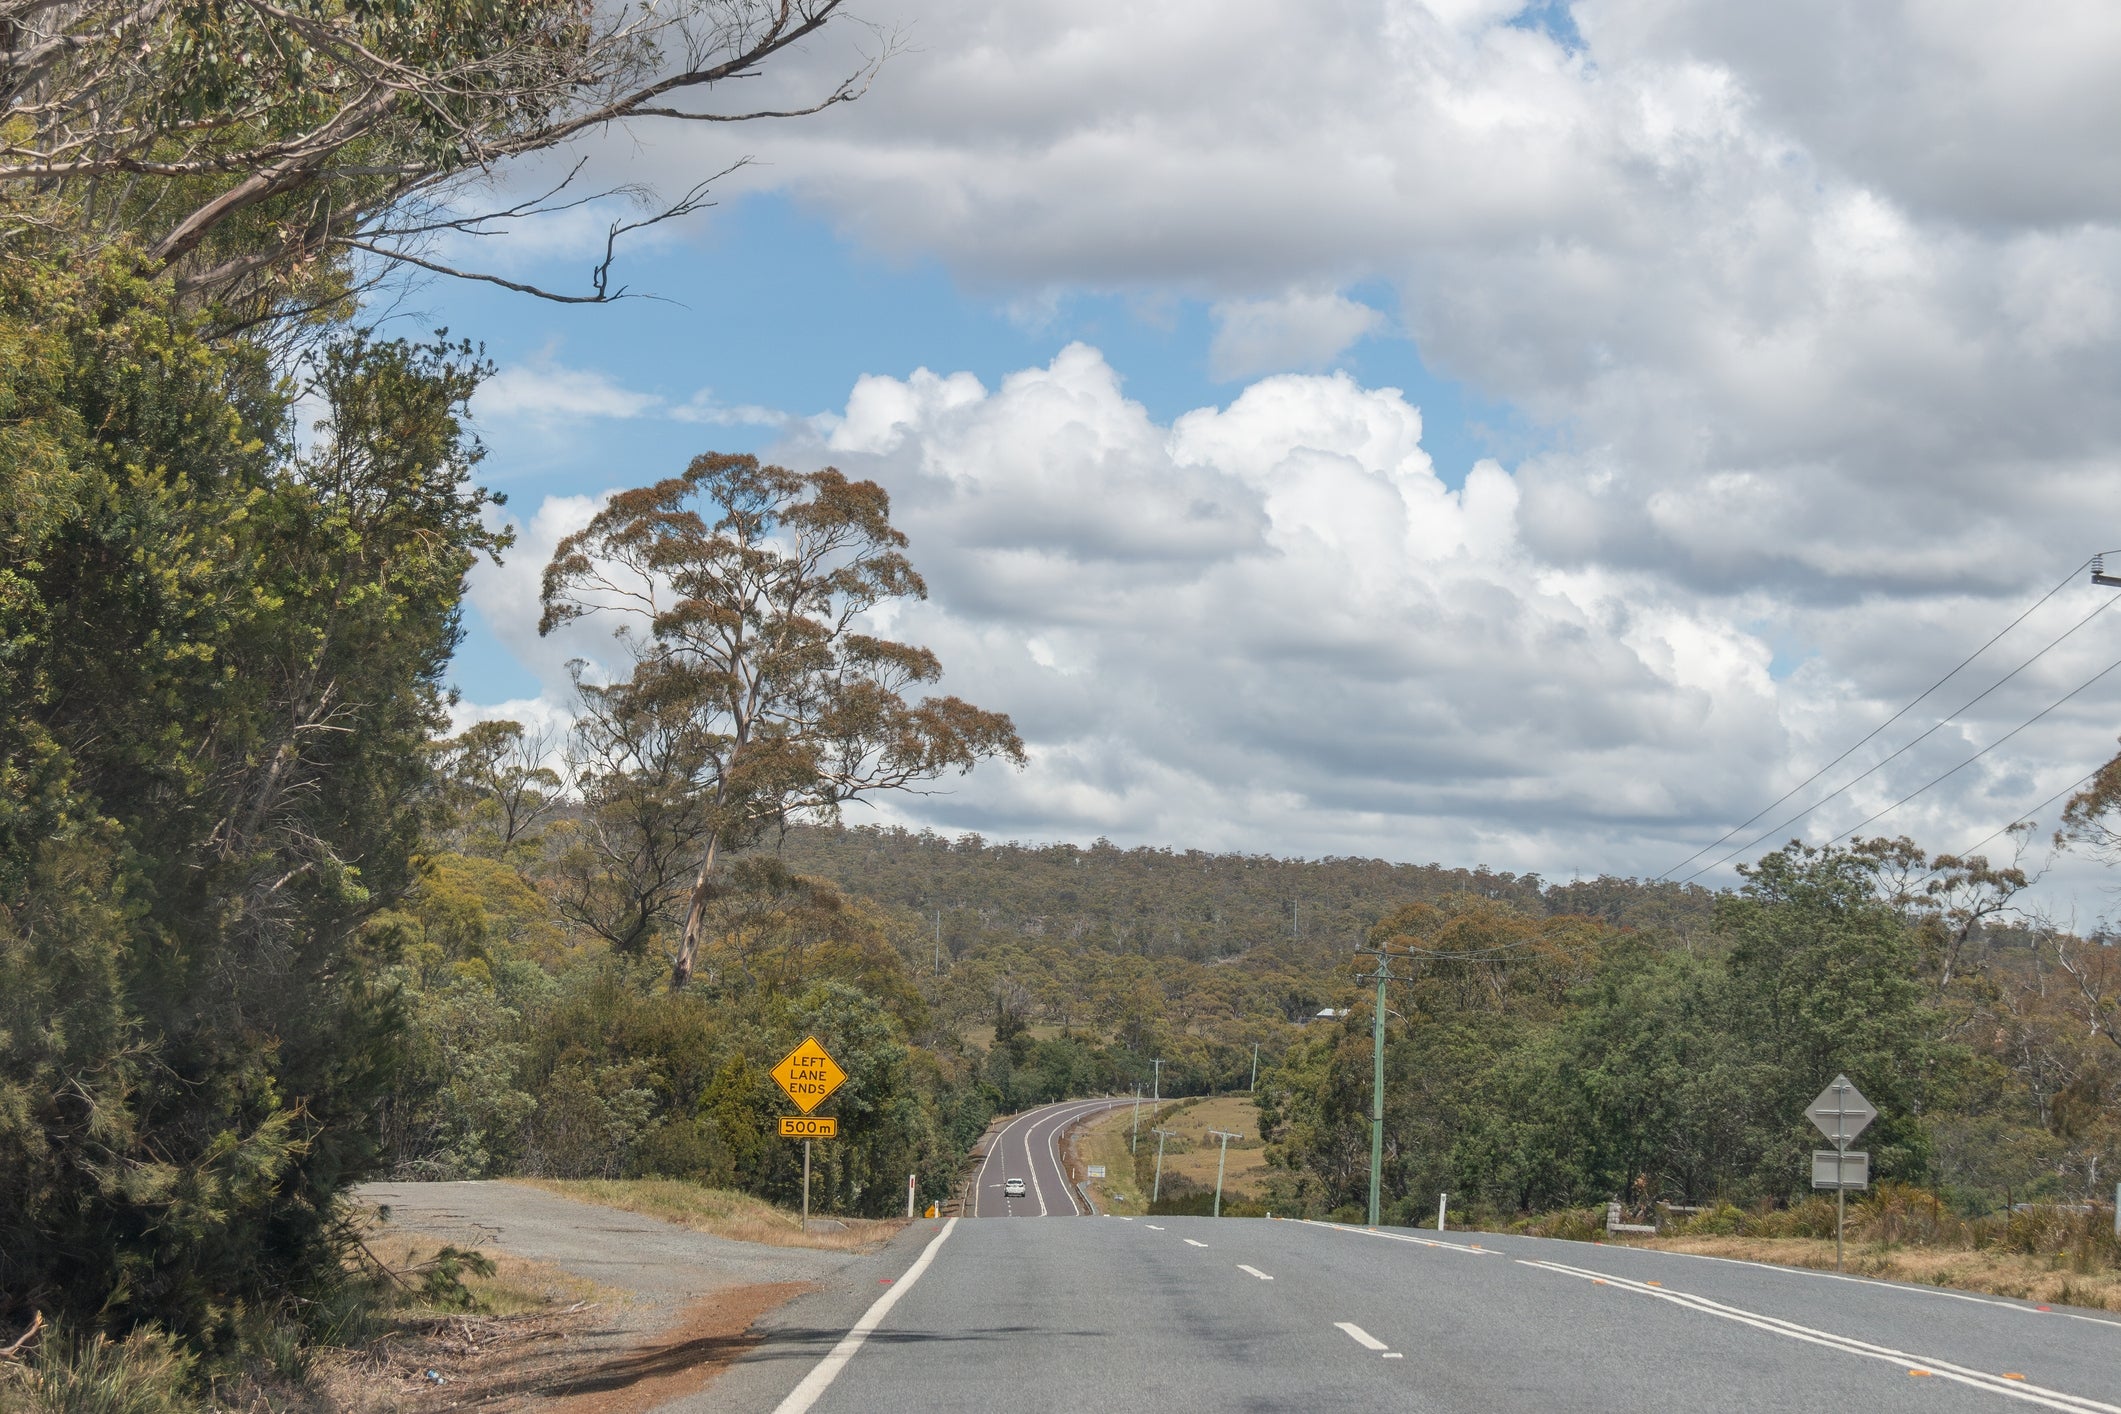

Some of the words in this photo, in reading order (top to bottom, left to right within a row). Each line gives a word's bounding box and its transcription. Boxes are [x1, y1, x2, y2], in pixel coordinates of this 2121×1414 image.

[793, 1056, 826, 1067] LEFT
[790, 1069, 827, 1081] LANE
[789, 1083, 826, 1095] ENDS
[785, 1121, 816, 1133] 500
[819, 1125, 831, 1133] m
